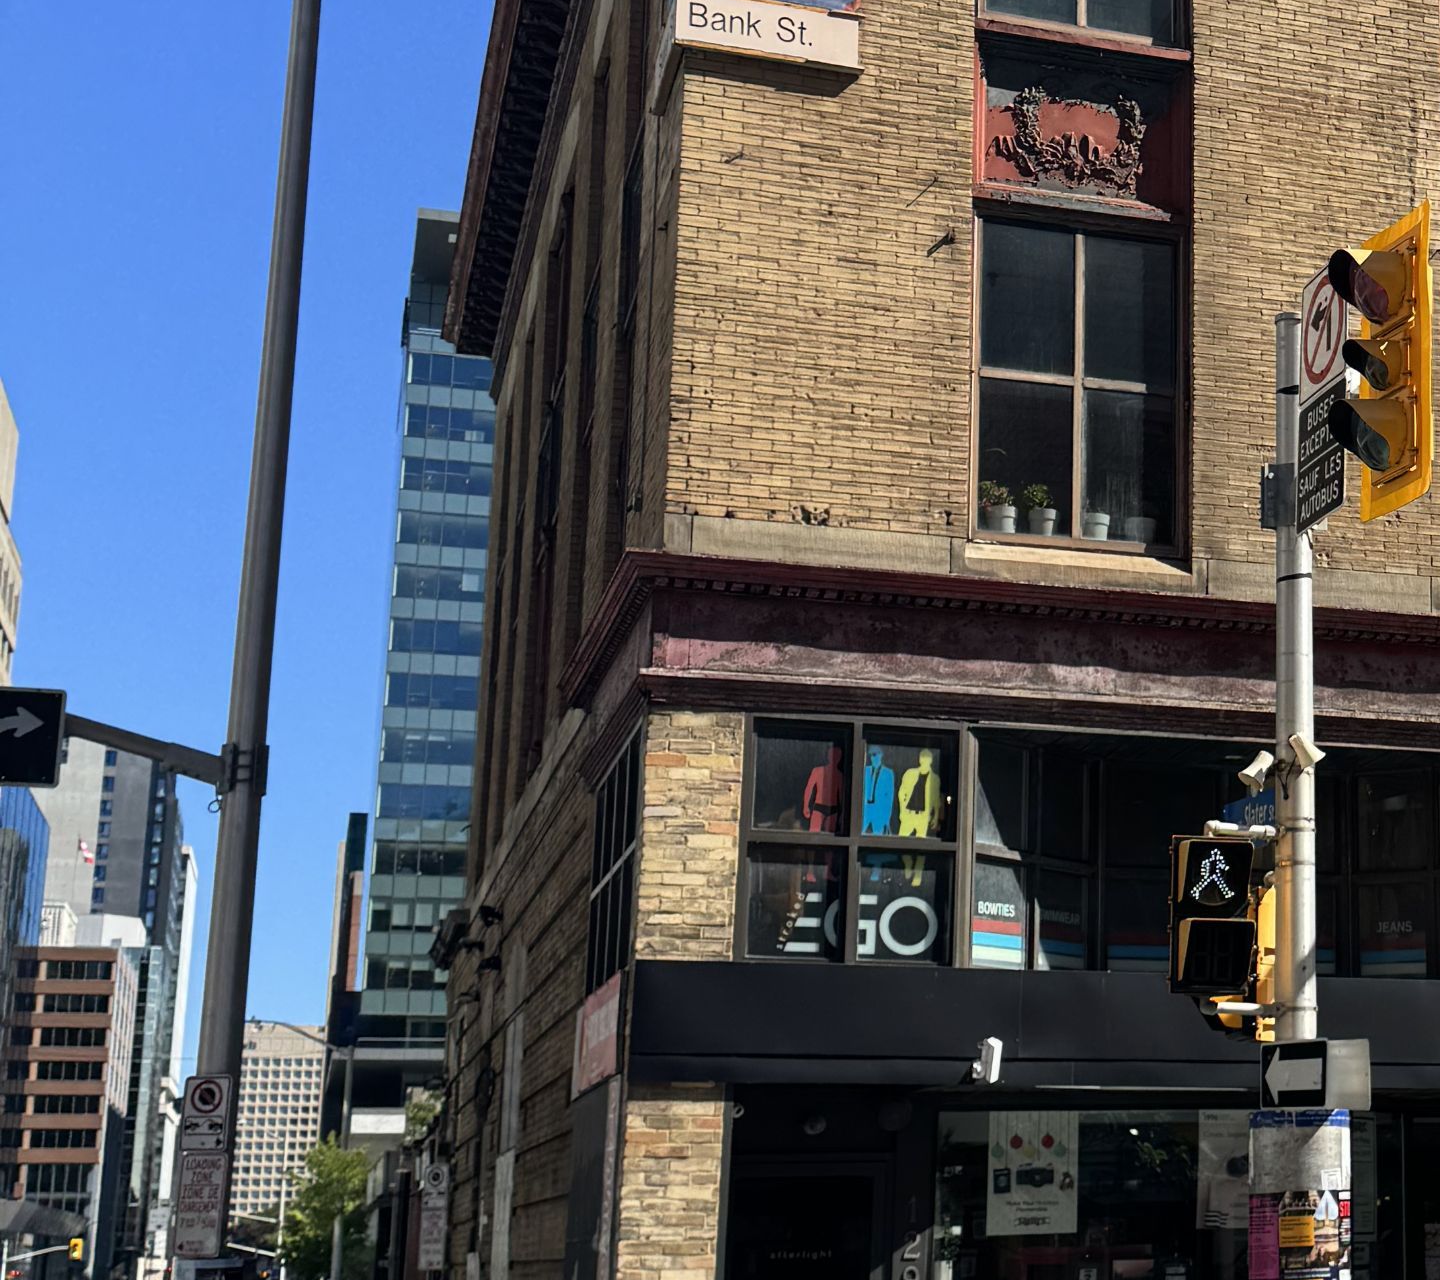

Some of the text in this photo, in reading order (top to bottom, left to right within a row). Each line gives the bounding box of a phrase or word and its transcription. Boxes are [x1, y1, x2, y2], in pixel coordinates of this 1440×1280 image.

[689, 2, 812, 47] Bank St.
[1299, 451, 1342, 498] SAUF LES
[1300, 479, 1340, 522] AUTOBUS
[783, 892, 938, 956] EGO
[977, 901, 1016, 918] BOWTIES
[1376, 921, 1413, 933] JEANS
